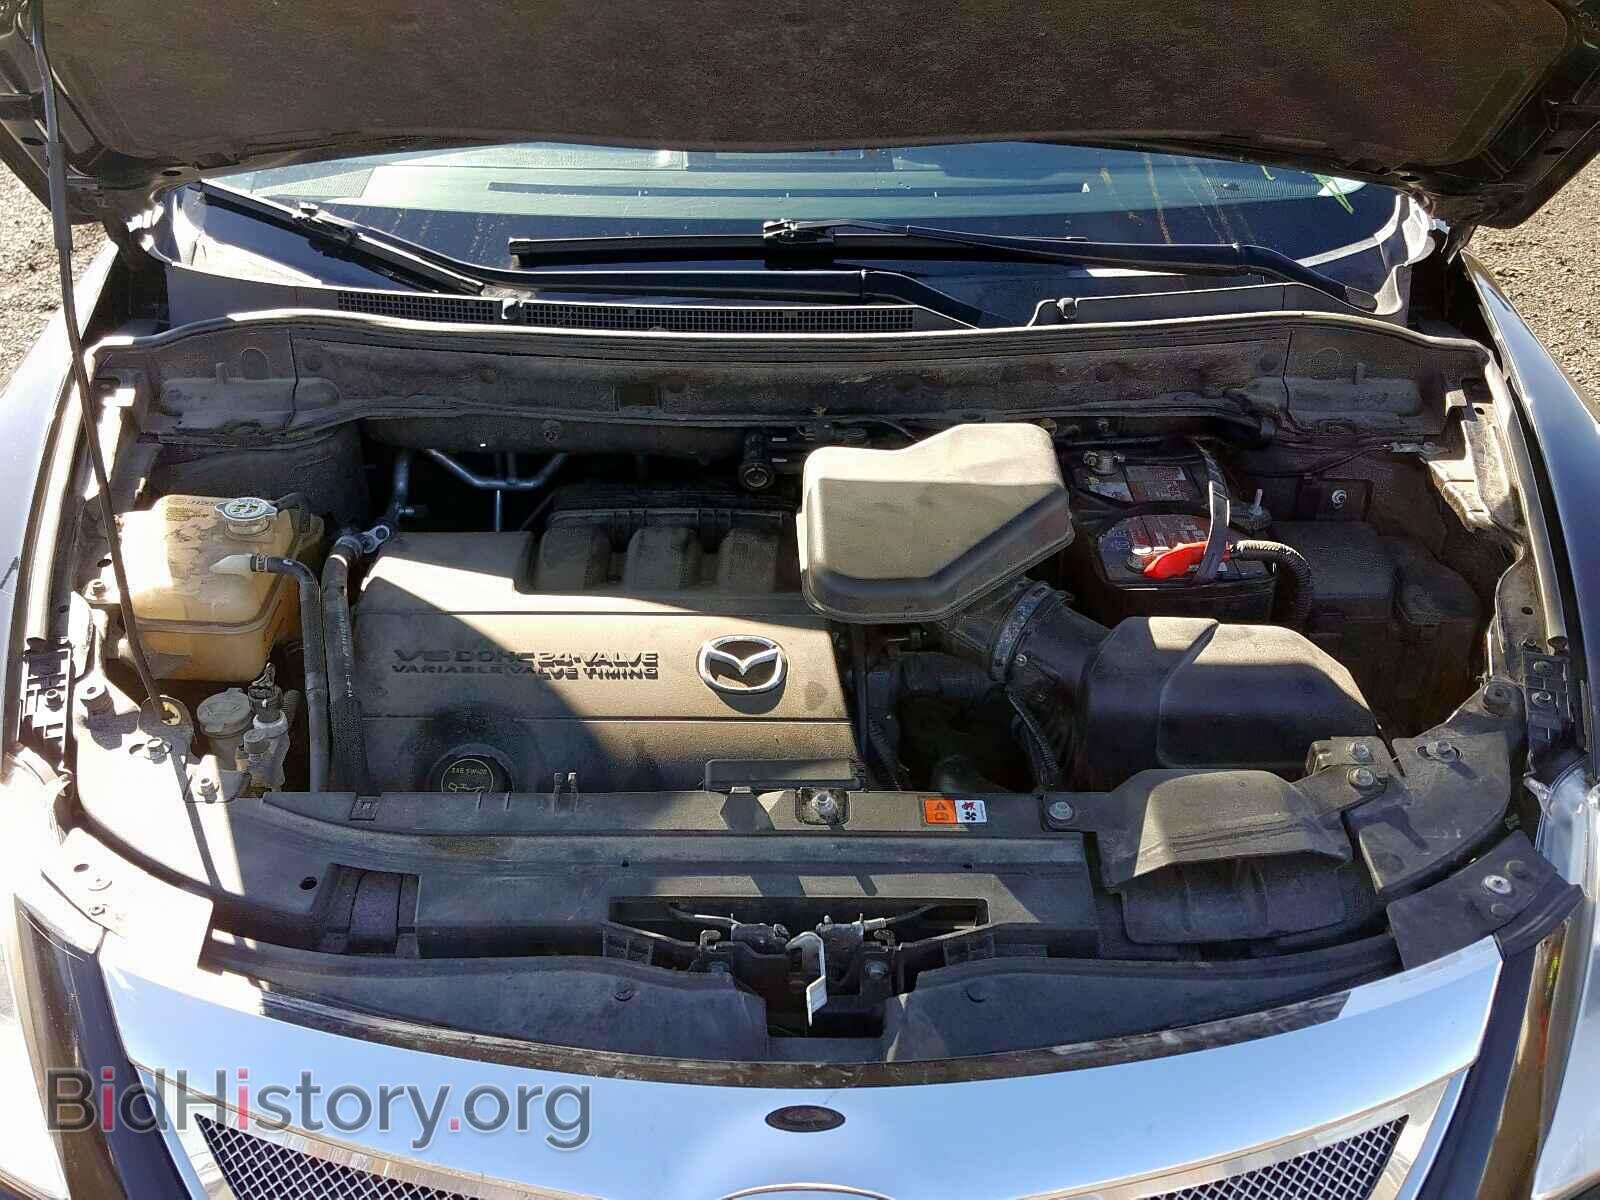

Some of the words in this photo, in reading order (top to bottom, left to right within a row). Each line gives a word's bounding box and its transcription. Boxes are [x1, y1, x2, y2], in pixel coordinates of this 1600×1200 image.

[538, 651, 659, 668] 24-VALVE
[392, 664, 505, 675] VARIABLE
[507, 665, 579, 681] VALVE
[583, 667, 659, 681] TIMING
